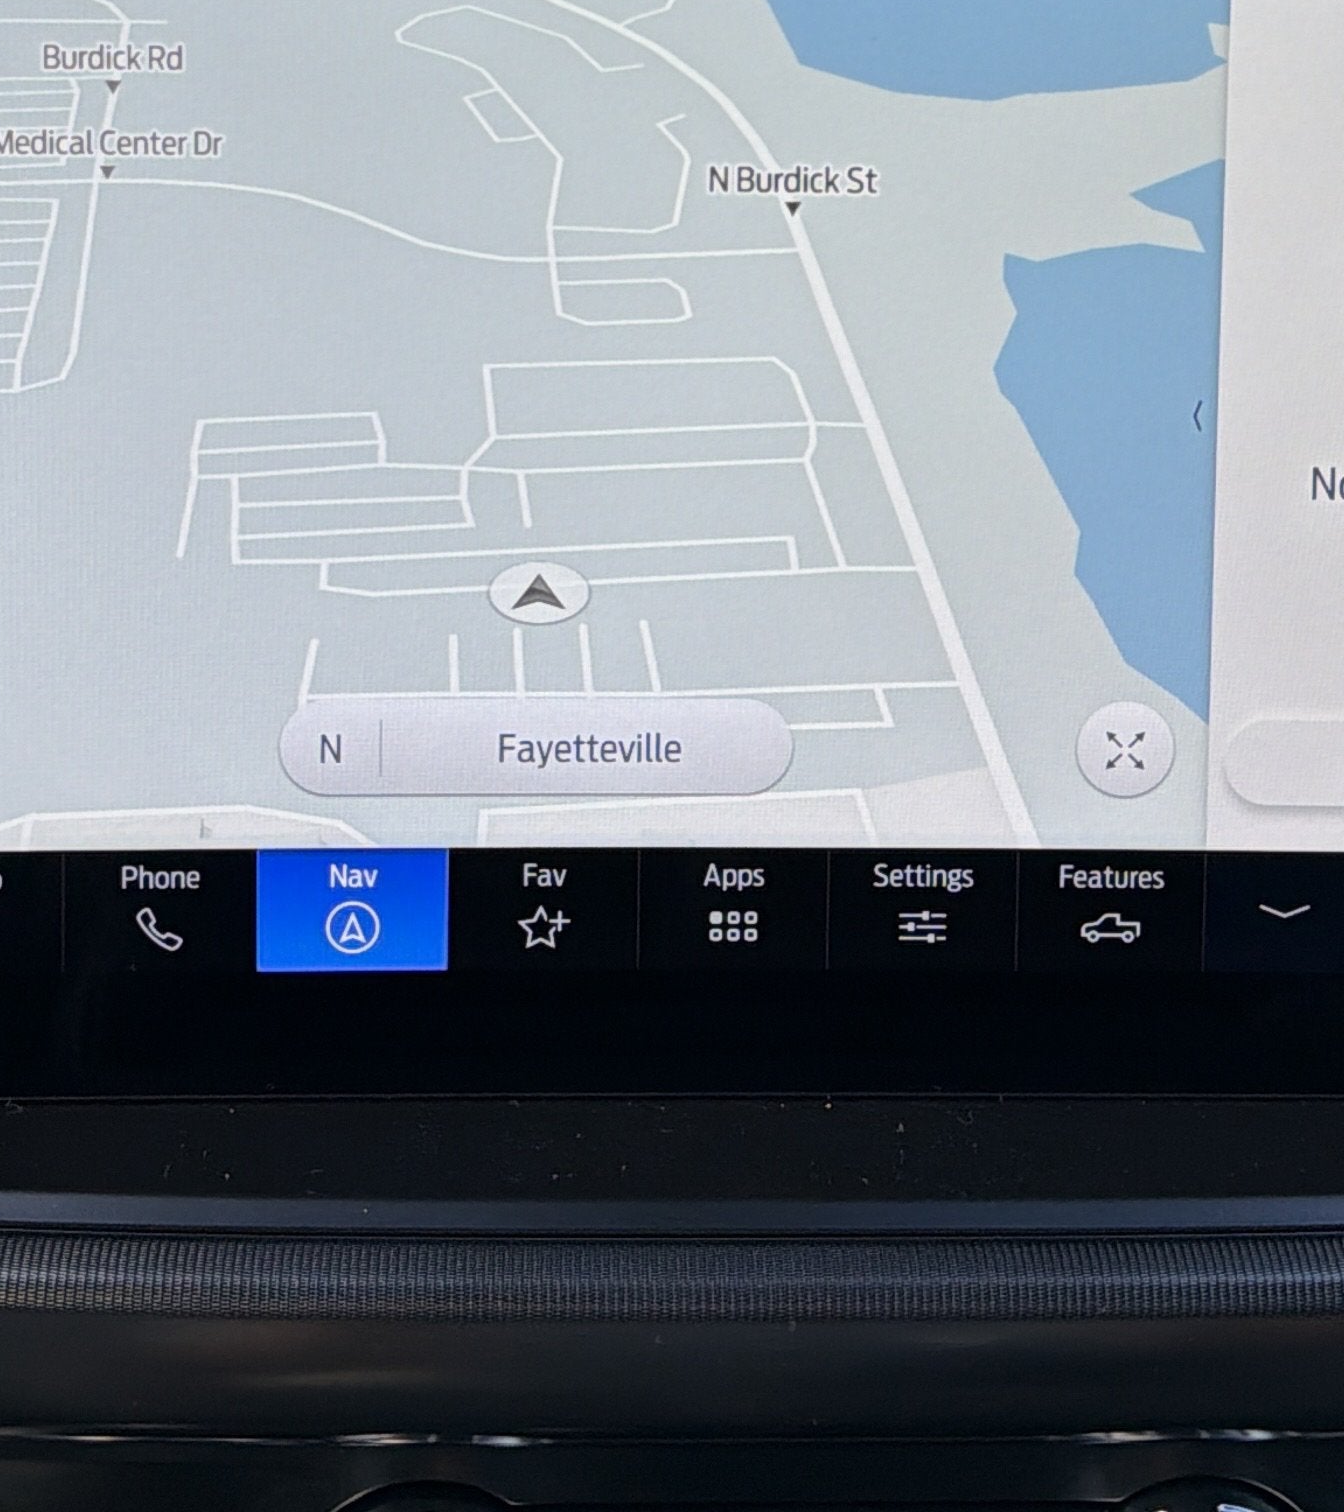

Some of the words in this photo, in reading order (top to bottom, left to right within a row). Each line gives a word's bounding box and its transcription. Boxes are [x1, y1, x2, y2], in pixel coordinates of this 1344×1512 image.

[42, 43, 142, 71] Burdick
[148, 44, 184, 71] Rd
[99, 129, 188, 156] Center
[193, 130, 224, 156] Dr
[708, 165, 729, 193] N
[736, 164, 841, 194] Burdick
[846, 166, 878, 194] St
[319, 733, 343, 764] N
[498, 732, 683, 770] Fayetteville
[119, 864, 202, 892] Phone
[328, 863, 379, 890] Nav
[521, 862, 568, 888] Fav
[702, 863, 766, 893] Apps
[872, 862, 975, 894] Settings
[1057, 863, 1165, 892] Features
